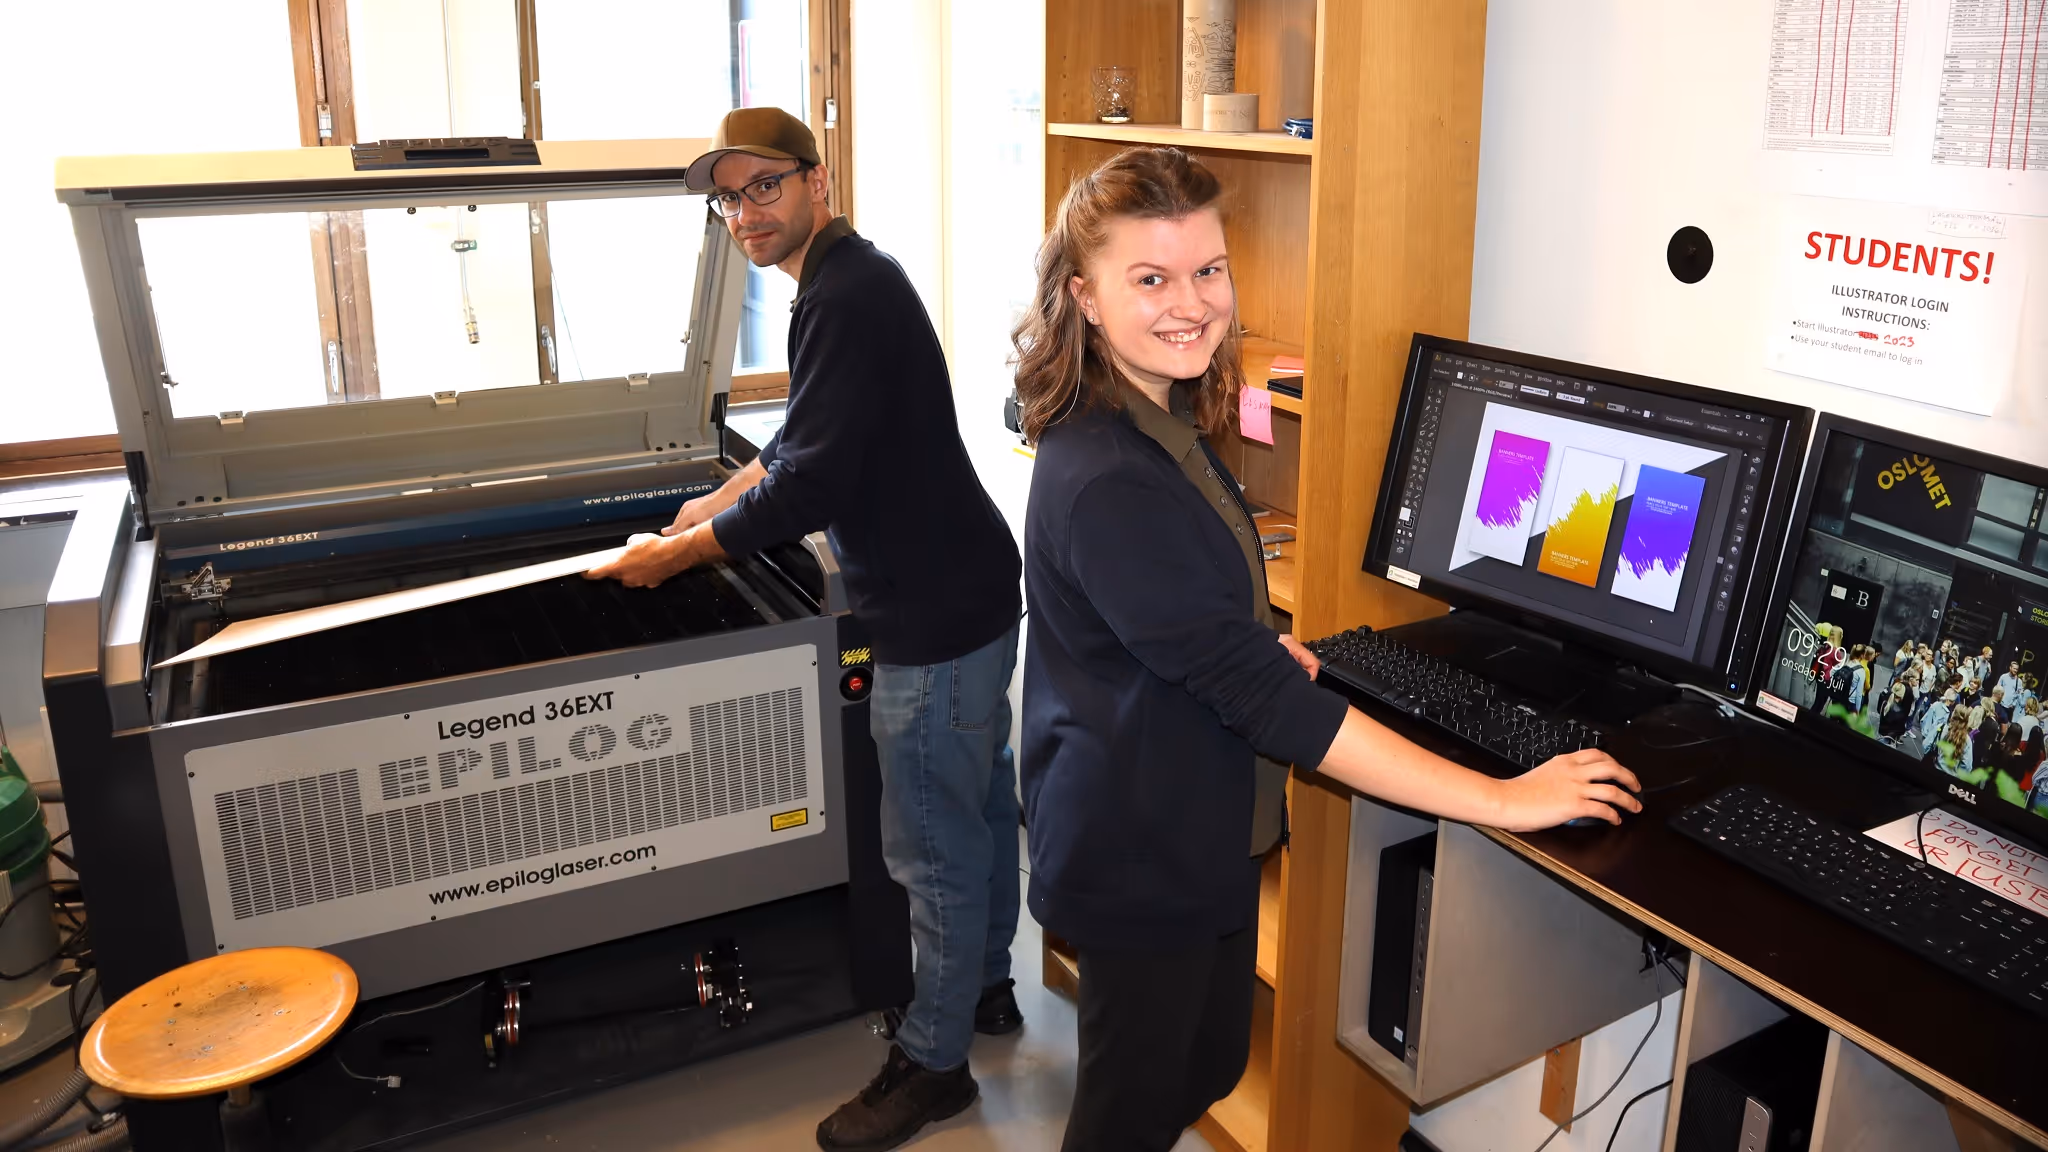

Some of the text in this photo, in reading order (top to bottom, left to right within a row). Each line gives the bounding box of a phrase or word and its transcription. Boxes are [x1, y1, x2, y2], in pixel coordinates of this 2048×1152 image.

[1804, 231, 1994, 284] STUDENTS!
[1831, 285, 1949, 312] ILLUSTRATOR LOGIN
[1797, 319, 1815, 330] Start
[1842, 306, 1930, 330] INSTRUCTIONS:
[1795, 334, 1922, 365] Use your student email to log in
[1884, 334, 1915, 348] 2023
[583, 483, 712, 505] www.epiloglaser.com
[220, 531, 319, 551] Legend 36EXT
[1856, 590, 1869, 607] B
[1788, 628, 1846, 670] 09:29
[1781, 658, 1816, 681] onsdag
[1818, 671, 1826, 684] 3.
[437, 691, 614, 740] Legend 36EXT
[378, 713, 673, 800] EPILOG
[1948, 784, 1977, 805] DELL
[1924, 829, 2044, 877] FORGET
[1986, 837, 2048, 862] NOT
[428, 844, 657, 905] www.epiloglaser.com
